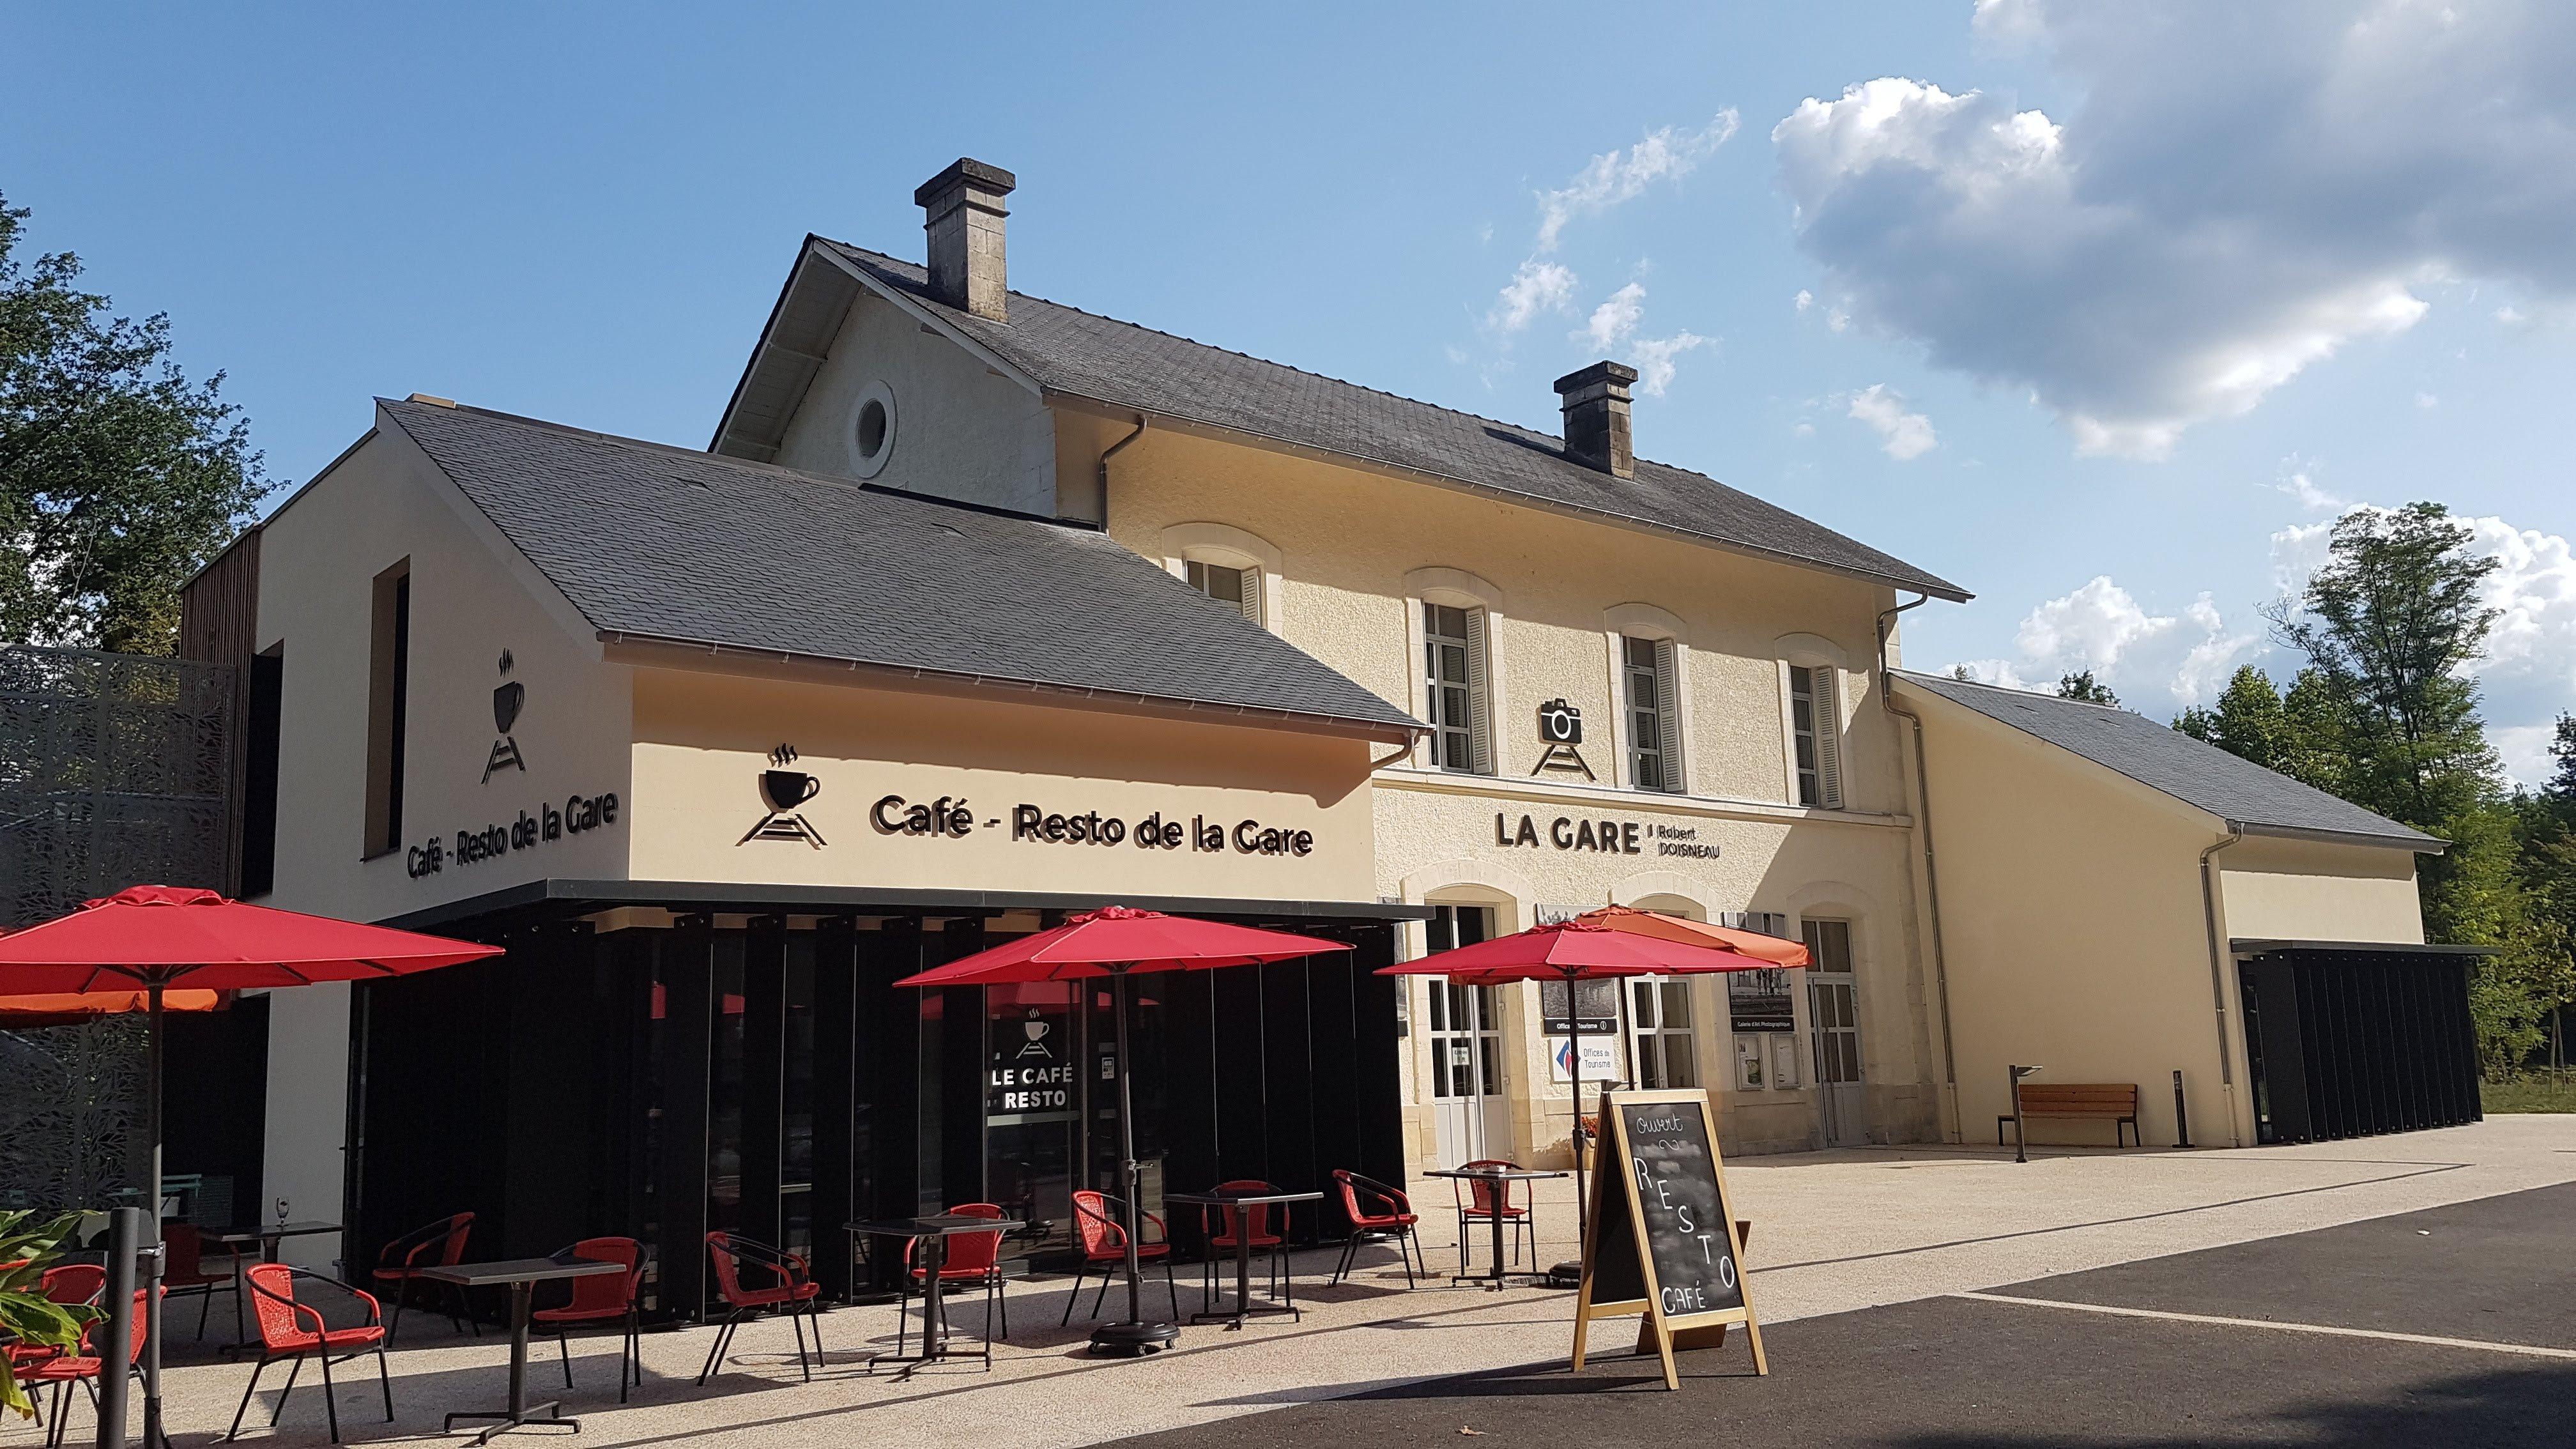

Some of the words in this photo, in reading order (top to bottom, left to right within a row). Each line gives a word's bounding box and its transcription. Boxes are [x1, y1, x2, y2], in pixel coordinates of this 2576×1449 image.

[877, 795, 974, 834] Café
[1018, 804, 1126, 843] Resto
[1139, 811, 1183, 846] de
[1197, 815, 1224, 849] la
[1238, 819, 1314, 854] Gare
[1498, 813, 1540, 847] LA
[1552, 816, 1641, 854] GARE
[1659, 825, 1697, 840] Robert
[408, 836, 443, 878] Café
[456, 824, 508, 866] Resto
[511, 809, 538, 850] de
[542, 802, 561, 842] la
[565, 793, 618, 833] Gare
[1659, 842, 1720, 859] DOISNEAU
[1583, 1048, 1603, 1057] Offices
[992, 1069, 1015, 1085] LE
[1022, 1062, 1073, 1084] CAFÉ
[1584, 1060, 1611, 1068] Tourisme
[1005, 1090, 1066, 1108] RESTO
[1661, 1280, 1706, 1314] CAFÉ
